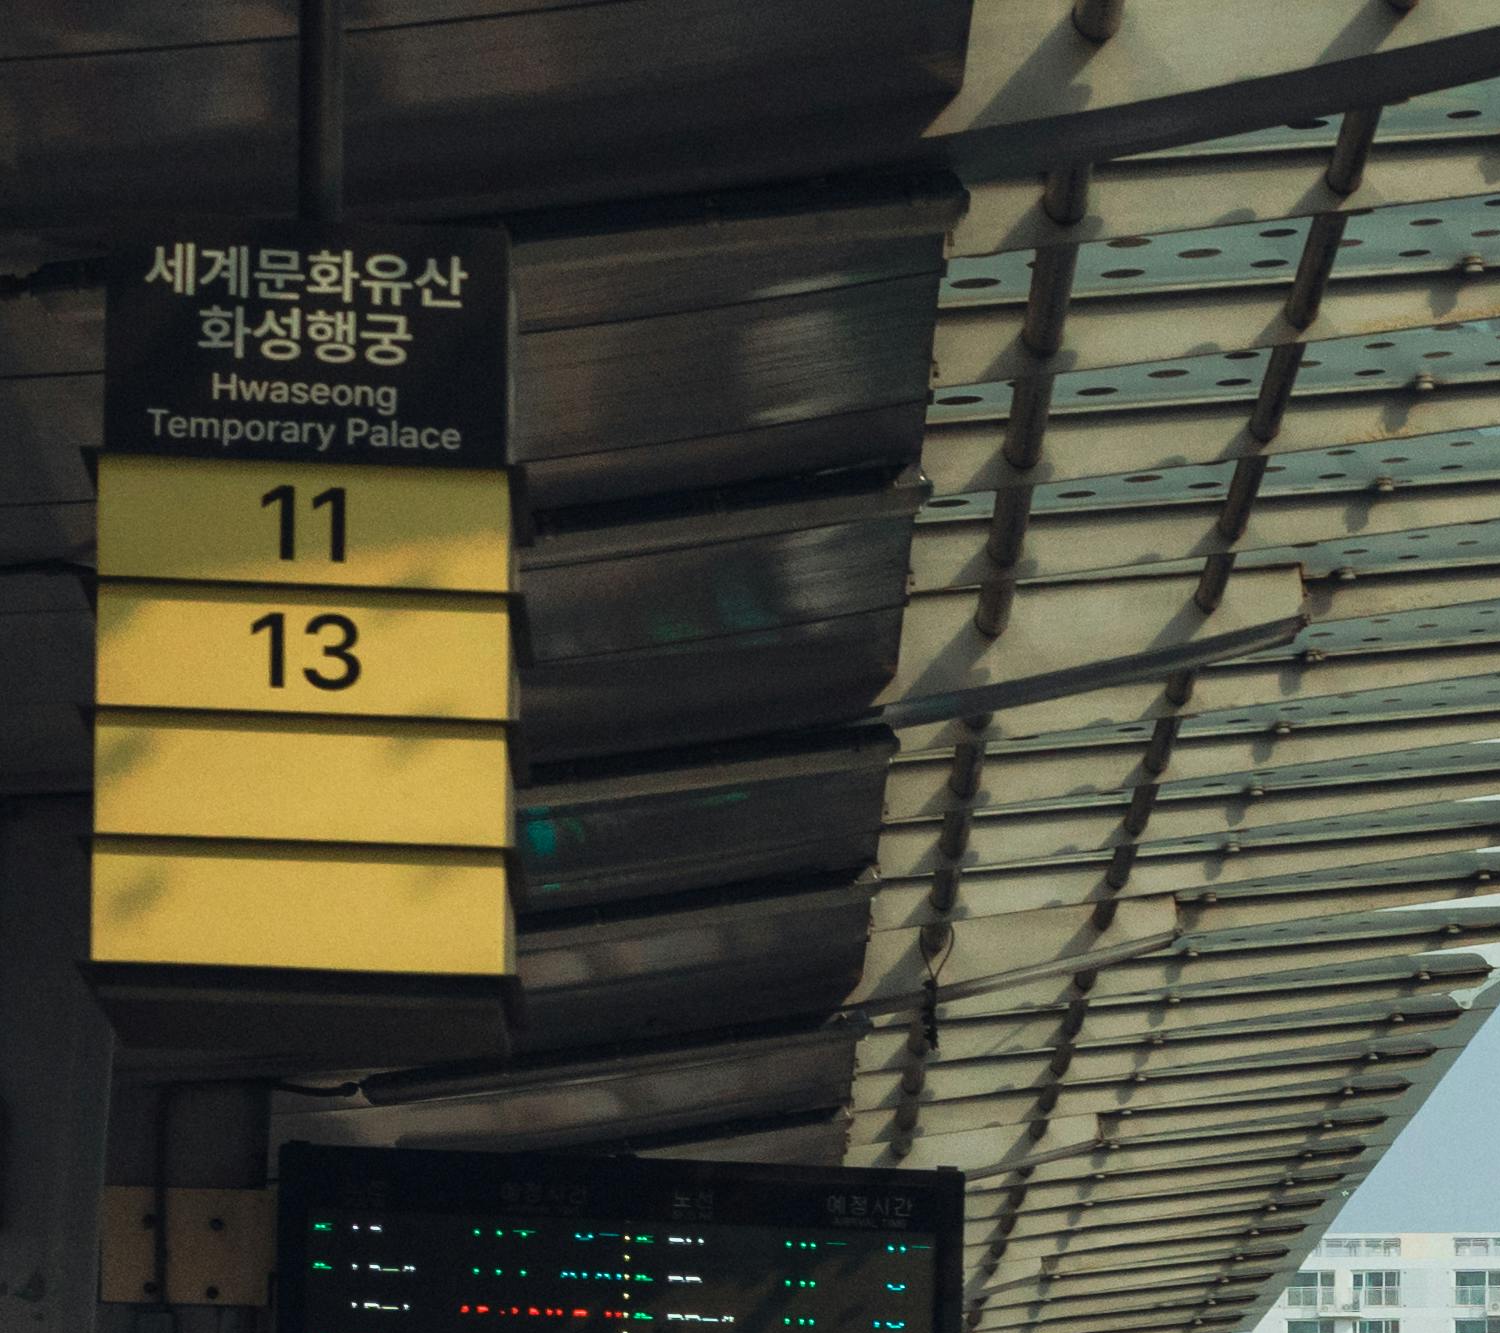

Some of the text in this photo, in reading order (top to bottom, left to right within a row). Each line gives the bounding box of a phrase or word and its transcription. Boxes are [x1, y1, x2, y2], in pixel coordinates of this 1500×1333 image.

[144, 242, 467, 309] 세계문화유산
[198, 306, 413, 366] 화성행궁
[212, 373, 398, 414] Hwaseong
[148, 408, 461, 452] Temporary Palace
[260, 485, 348, 563] 11
[250, 612, 362, 692] 13
